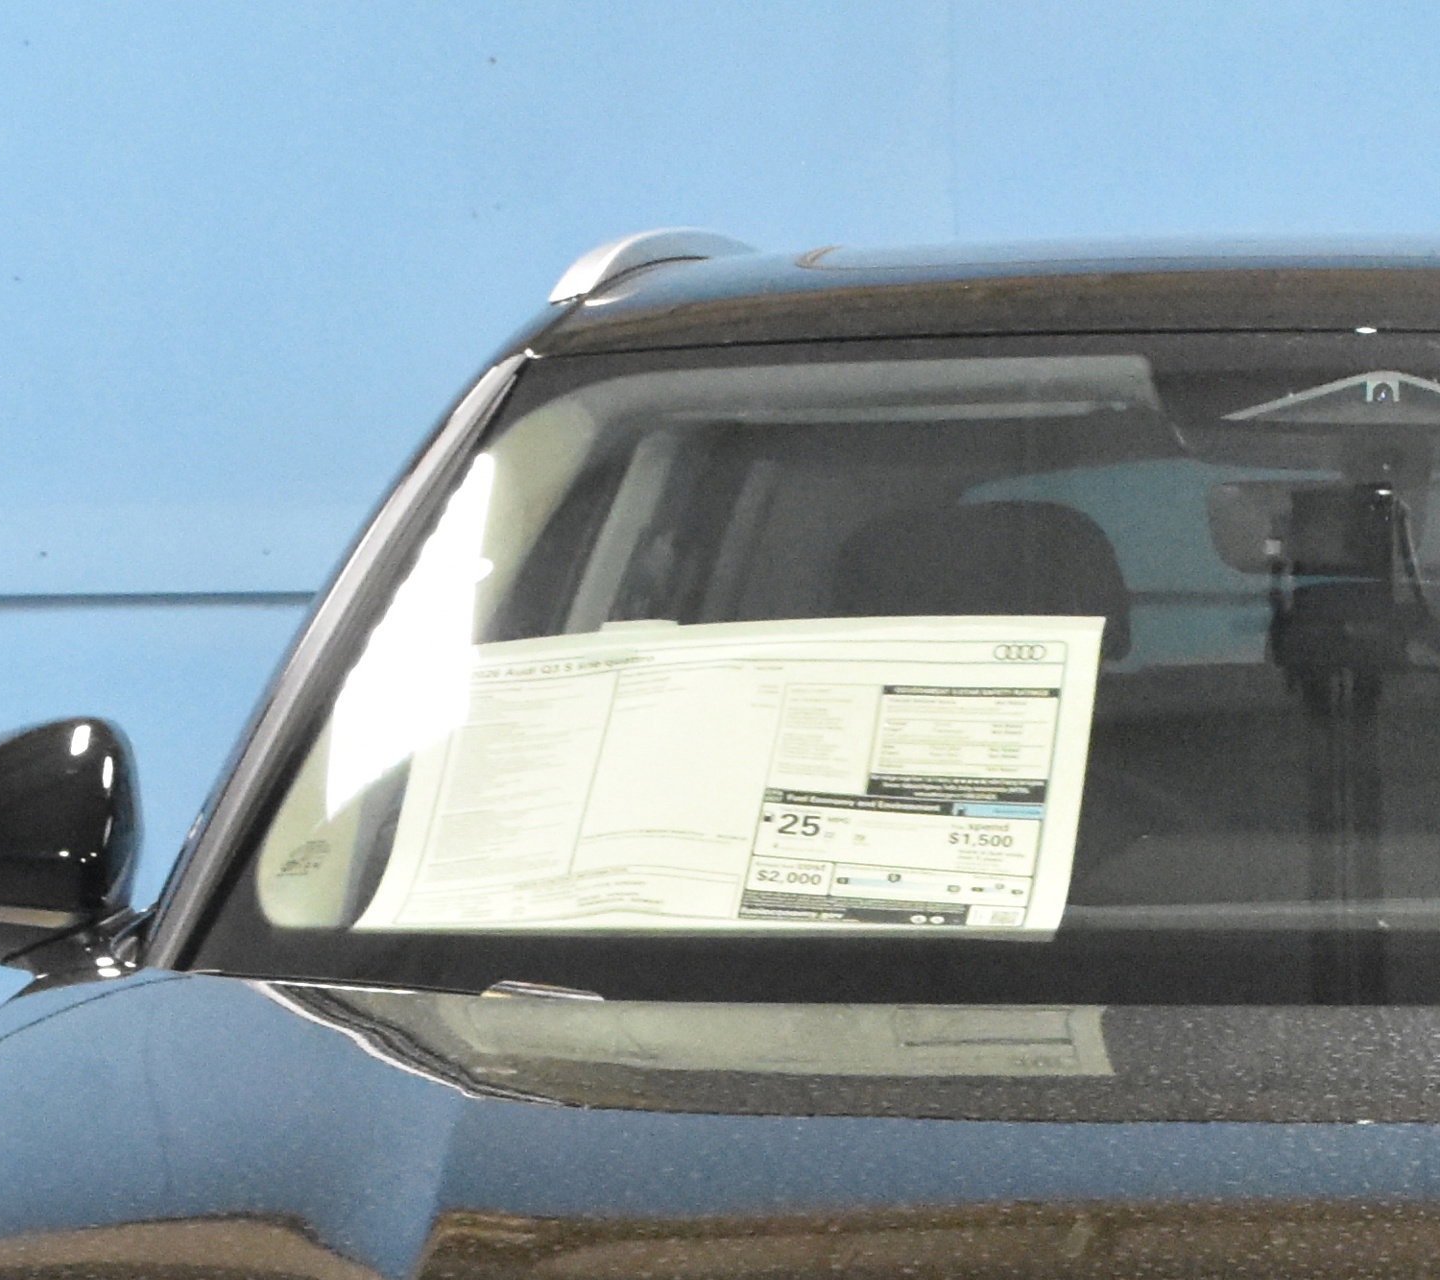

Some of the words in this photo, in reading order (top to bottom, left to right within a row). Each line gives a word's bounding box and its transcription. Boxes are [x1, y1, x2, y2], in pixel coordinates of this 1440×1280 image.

[777, 813, 821, 837] 25
[948, 831, 1014, 848] $1,500
[756, 869, 822, 886] $2,000
